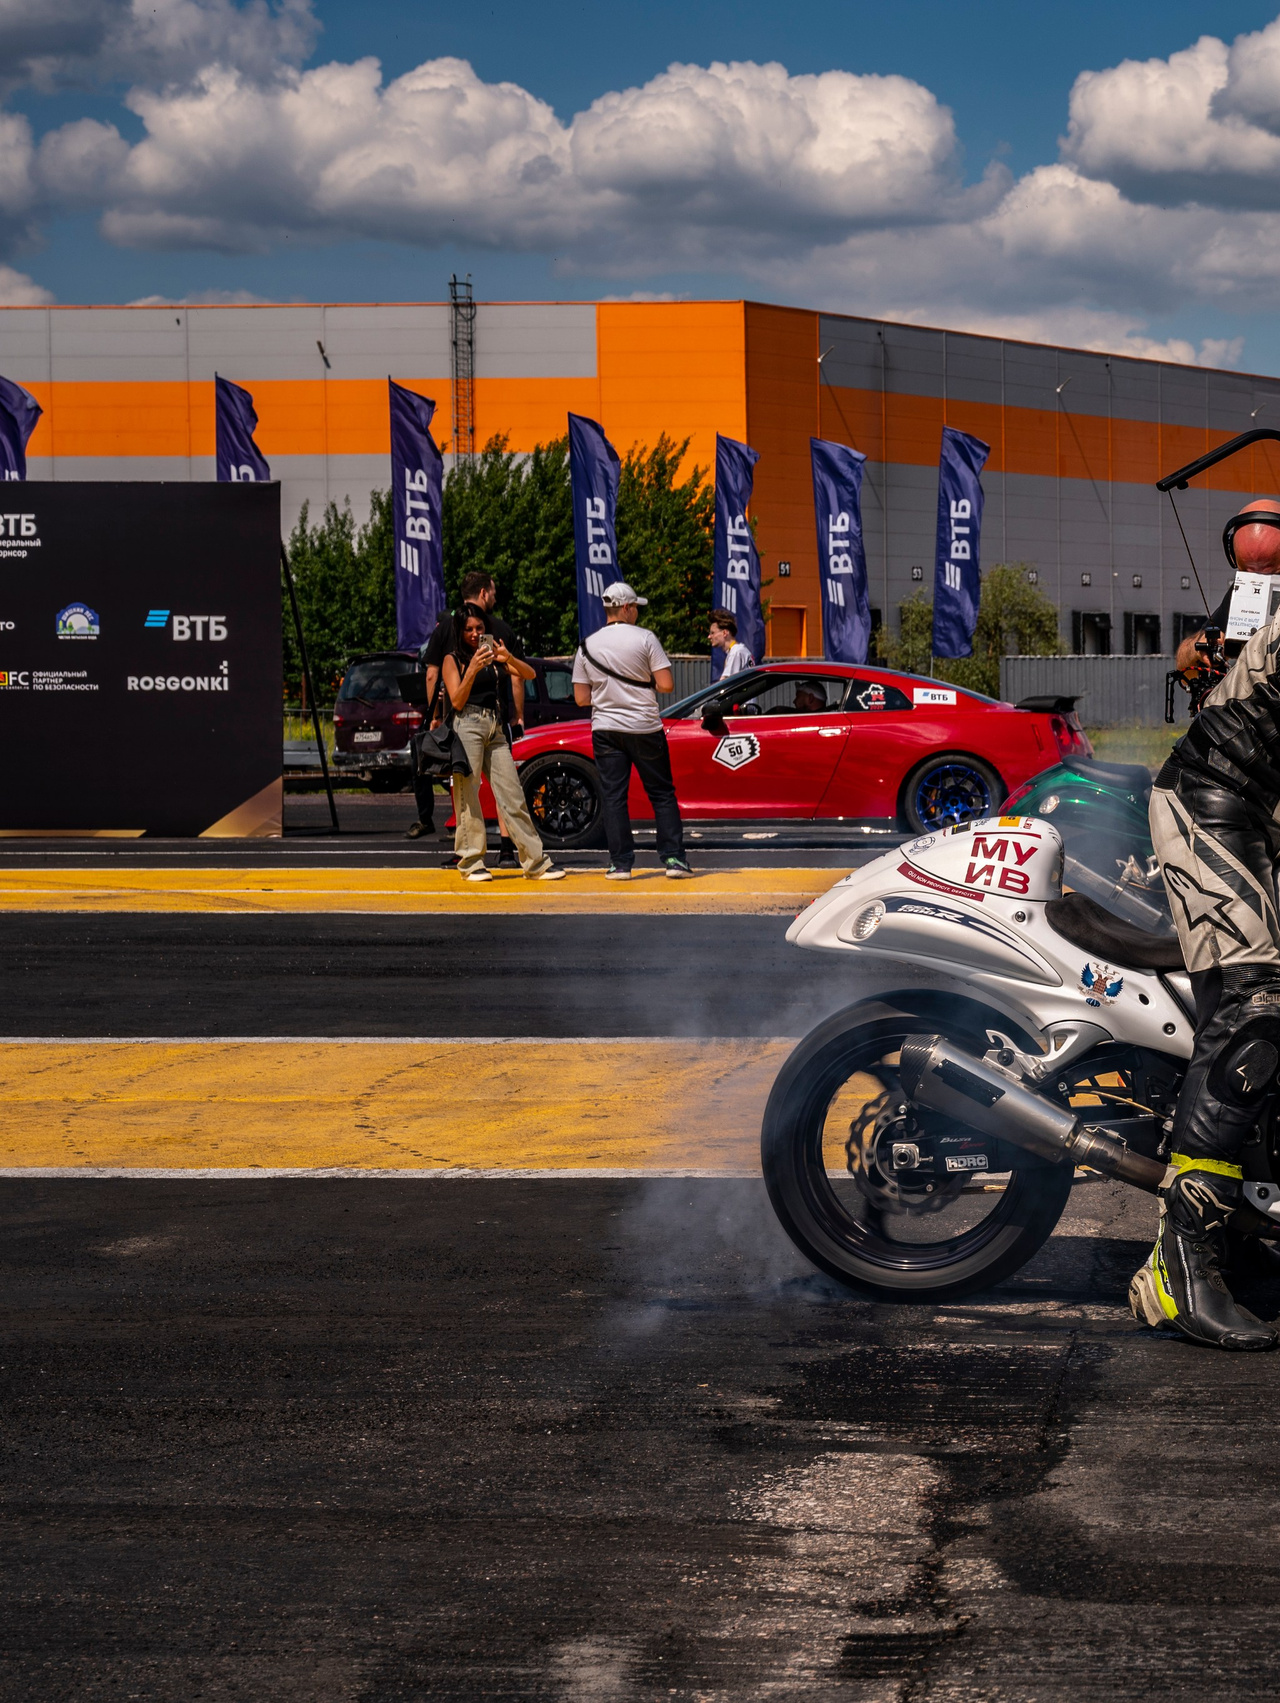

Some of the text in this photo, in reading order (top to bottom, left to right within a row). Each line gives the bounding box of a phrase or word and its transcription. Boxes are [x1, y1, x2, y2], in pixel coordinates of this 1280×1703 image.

[405, 467, 432, 542] ВТБ
[586, 497, 612, 565] ВТБ
[950, 499, 971, 560] ВТБ
[727, 514, 750, 581] ВТБ
[829, 511, 853, 575] ВТБ
[780, 563, 790, 575] 51
[912, 568, 922, 578] 53
[173, 615, 228, 641] ВТБ
[32, 670, 87, 678] ОФИЦИАЛЬНЫЙ
[127, 675, 229, 691] ROSGONKI
[930, 693, 949, 701] ВТБ
[728, 745, 743, 757] 50
[970, 836, 1039, 867] МУ
[964, 861, 1031, 895] ИВ
[947, 1156, 987, 1169] RDRC
